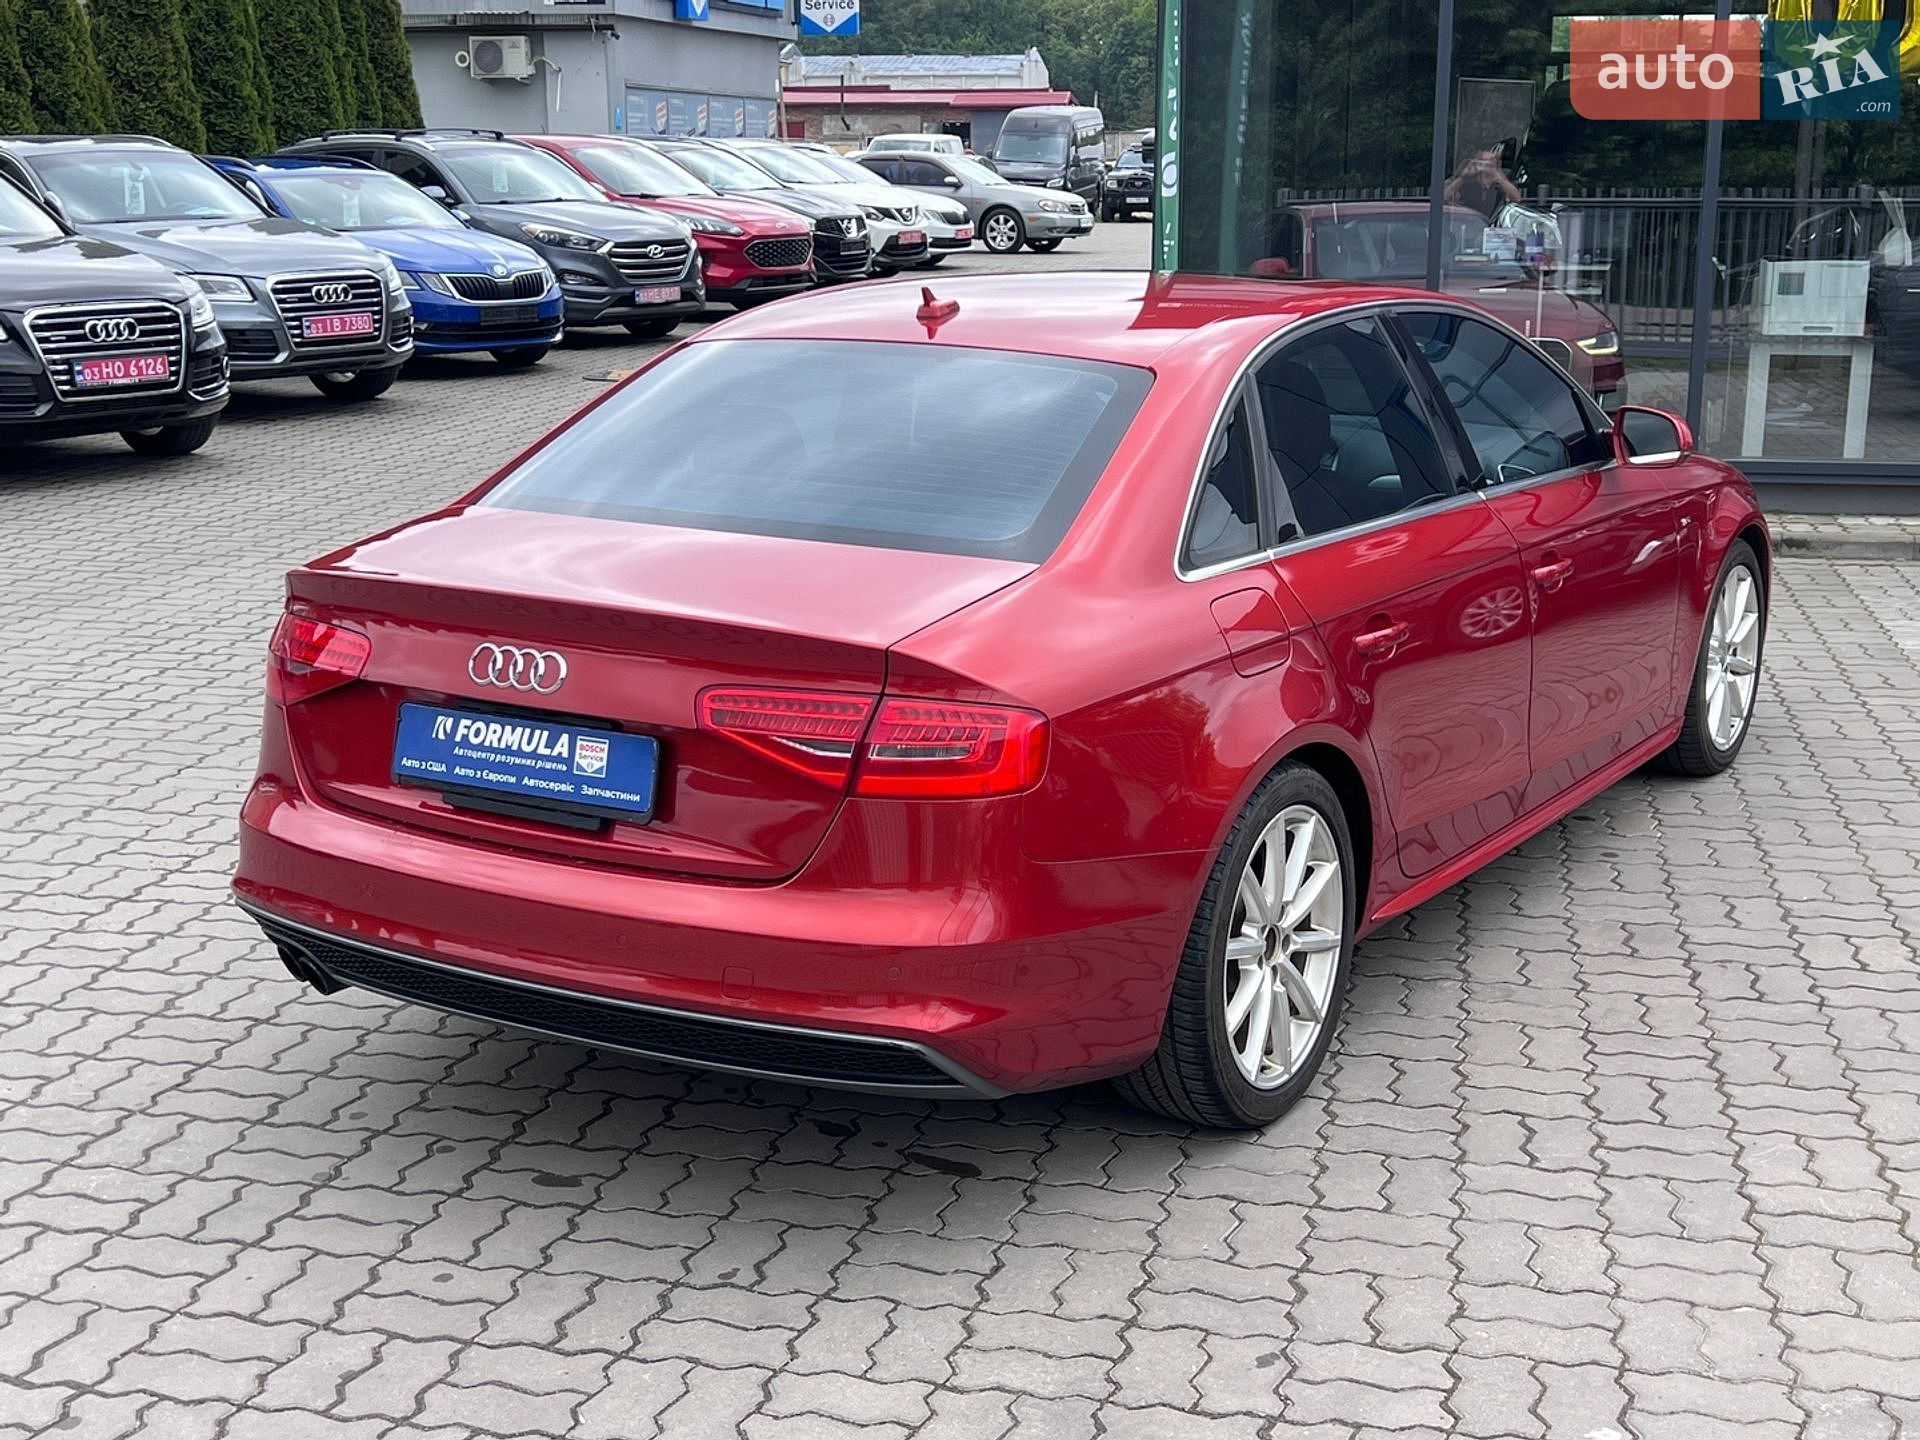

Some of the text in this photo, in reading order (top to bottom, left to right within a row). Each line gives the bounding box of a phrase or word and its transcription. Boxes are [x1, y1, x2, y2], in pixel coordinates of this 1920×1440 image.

[129, 357, 164, 376] 6126
[454, 719, 569, 757] FORMULA
[579, 743, 605, 754] BOSCH
[401, 757, 420, 769] Авто
[427, 761, 447, 772] США
[453, 746, 495, 762] Автоцентр
[536, 759, 568, 772] рішень
[454, 766, 474, 778] Авто
[482, 769, 517, 783] Європи
[522, 775, 576, 793] Автосервіс
[581, 784, 641, 803] Запчастини
